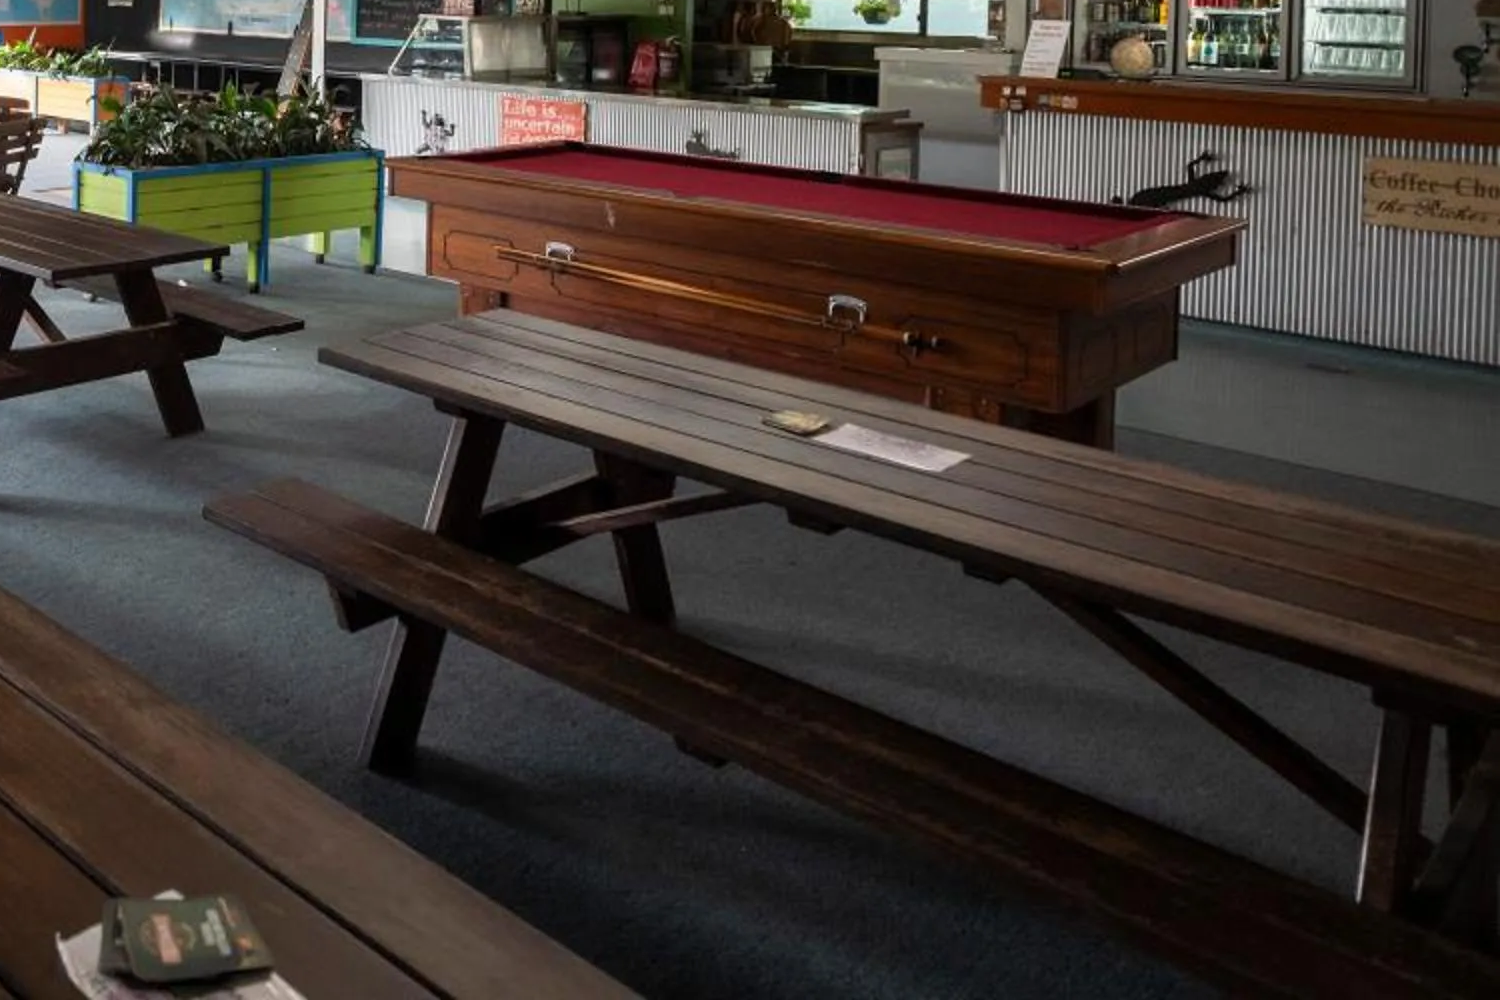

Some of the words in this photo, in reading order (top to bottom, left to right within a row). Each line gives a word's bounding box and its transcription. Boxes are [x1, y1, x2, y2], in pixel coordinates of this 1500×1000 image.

[504, 99, 537, 116] Life
[504, 117, 576, 137] uncertain
[1369, 168, 1439, 193] Coffee
